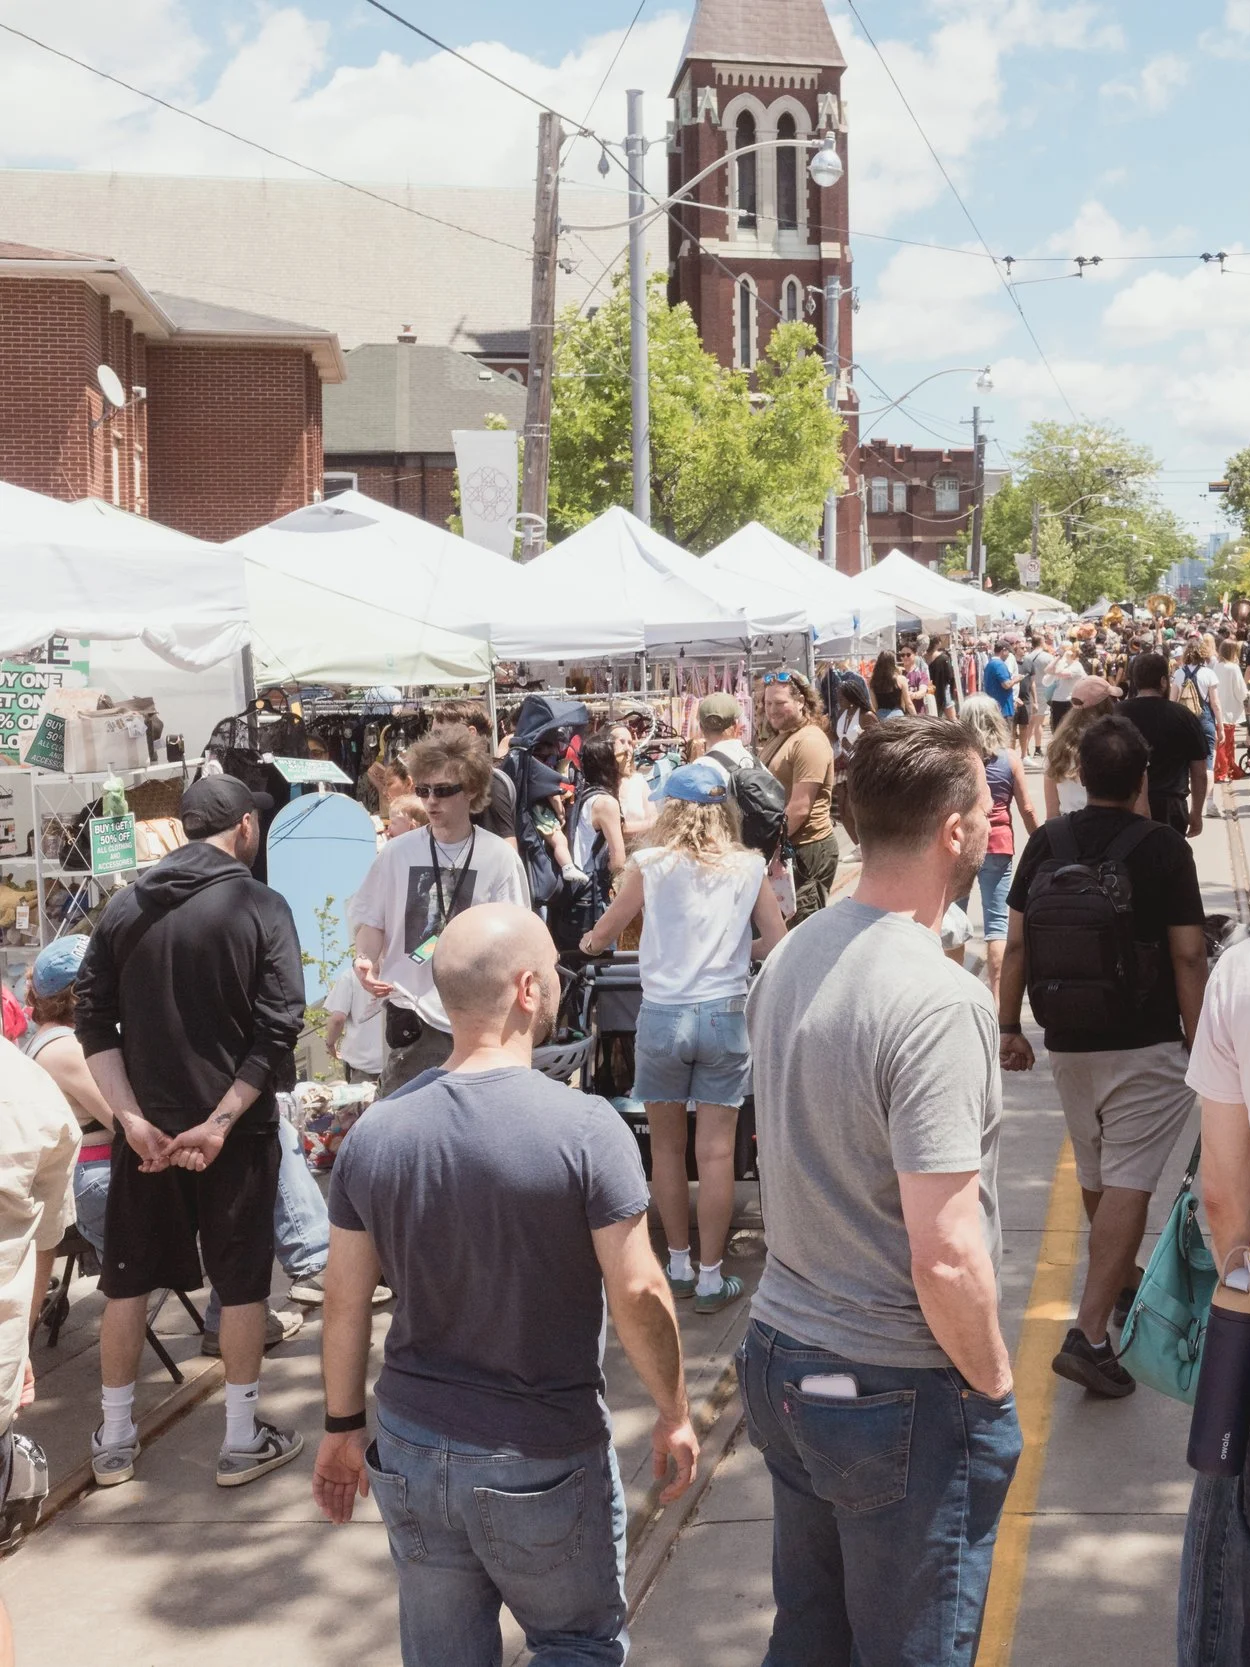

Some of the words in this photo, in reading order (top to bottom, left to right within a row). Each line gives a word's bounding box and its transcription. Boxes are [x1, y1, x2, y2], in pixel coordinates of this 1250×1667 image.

[20, 671, 63, 690] ONE
[17, 692, 46, 710] ON
[45, 718, 64, 731] BUY
[94, 823, 110, 835] BUY
[115, 820, 129, 831] GET
[100, 834, 117, 845] 50%
[118, 832, 131, 842] OFF
[108, 841, 133, 852] CLOTHING
[98, 857, 133, 870] ACCESSORIES
